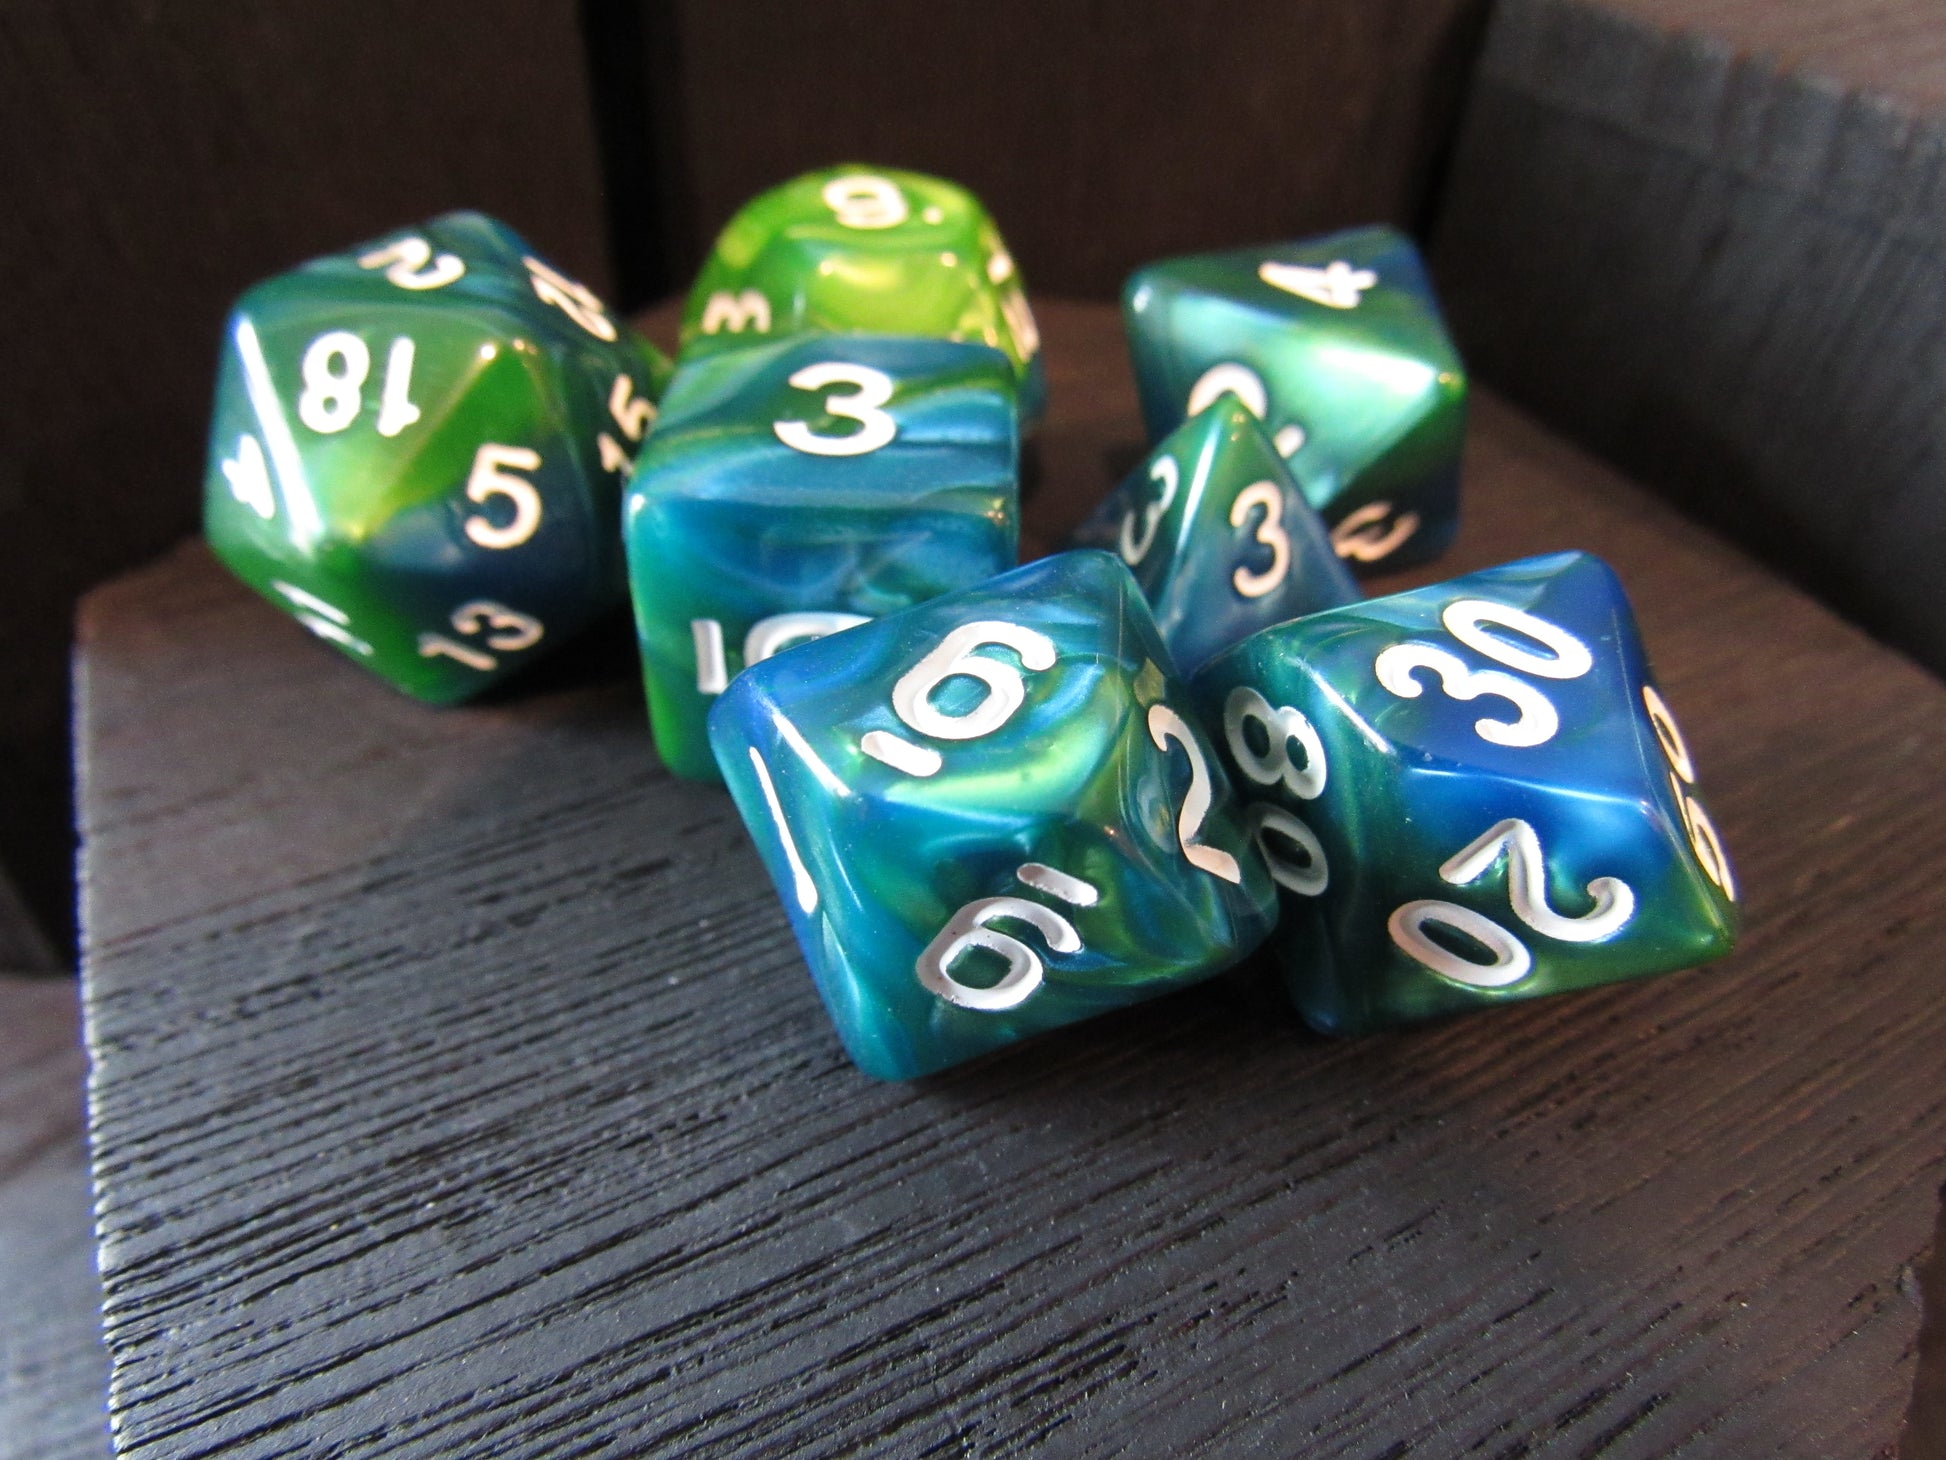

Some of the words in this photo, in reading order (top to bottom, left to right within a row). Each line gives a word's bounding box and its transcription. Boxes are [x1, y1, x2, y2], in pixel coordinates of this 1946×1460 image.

[359, 237, 466, 290] 2
[1258, 260, 1378, 309] 4
[300, 332, 421, 437] 18
[773, 361, 897, 456] 3
[465, 443, 541, 549] 5
[1230, 480, 1291, 599] 3
[419, 601, 544, 671] 13
[1375, 600, 1593, 748] 30
[1148, 703, 1241, 885] 2
[1224, 686, 1329, 897] 80
[1387, 817, 1635, 988] 20
